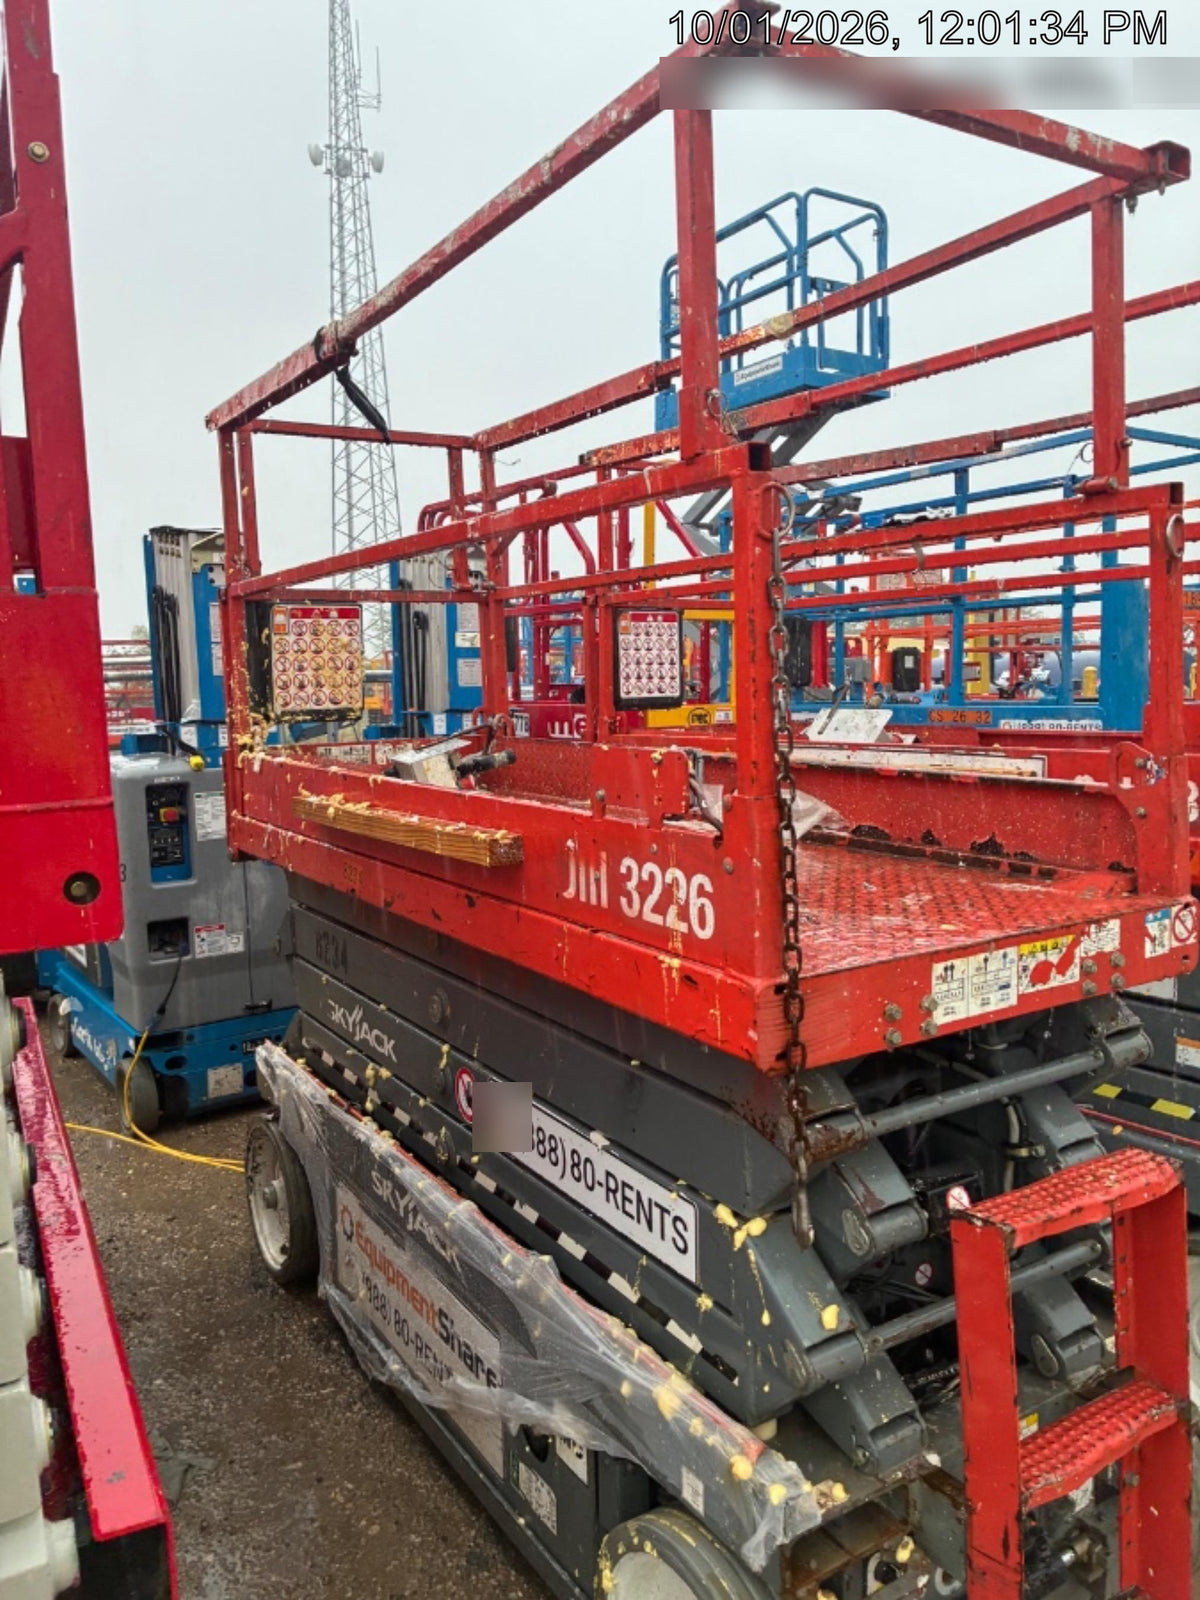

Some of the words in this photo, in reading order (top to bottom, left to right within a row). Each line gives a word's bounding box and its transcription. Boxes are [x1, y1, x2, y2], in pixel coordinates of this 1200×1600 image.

[953, 711, 966, 723] 26
[976, 711, 991, 724] 32
[619, 856, 715, 940] 3226
[532, 1118, 566, 1181] 88)
[570, 1148, 690, 1256] 80-RENTS
